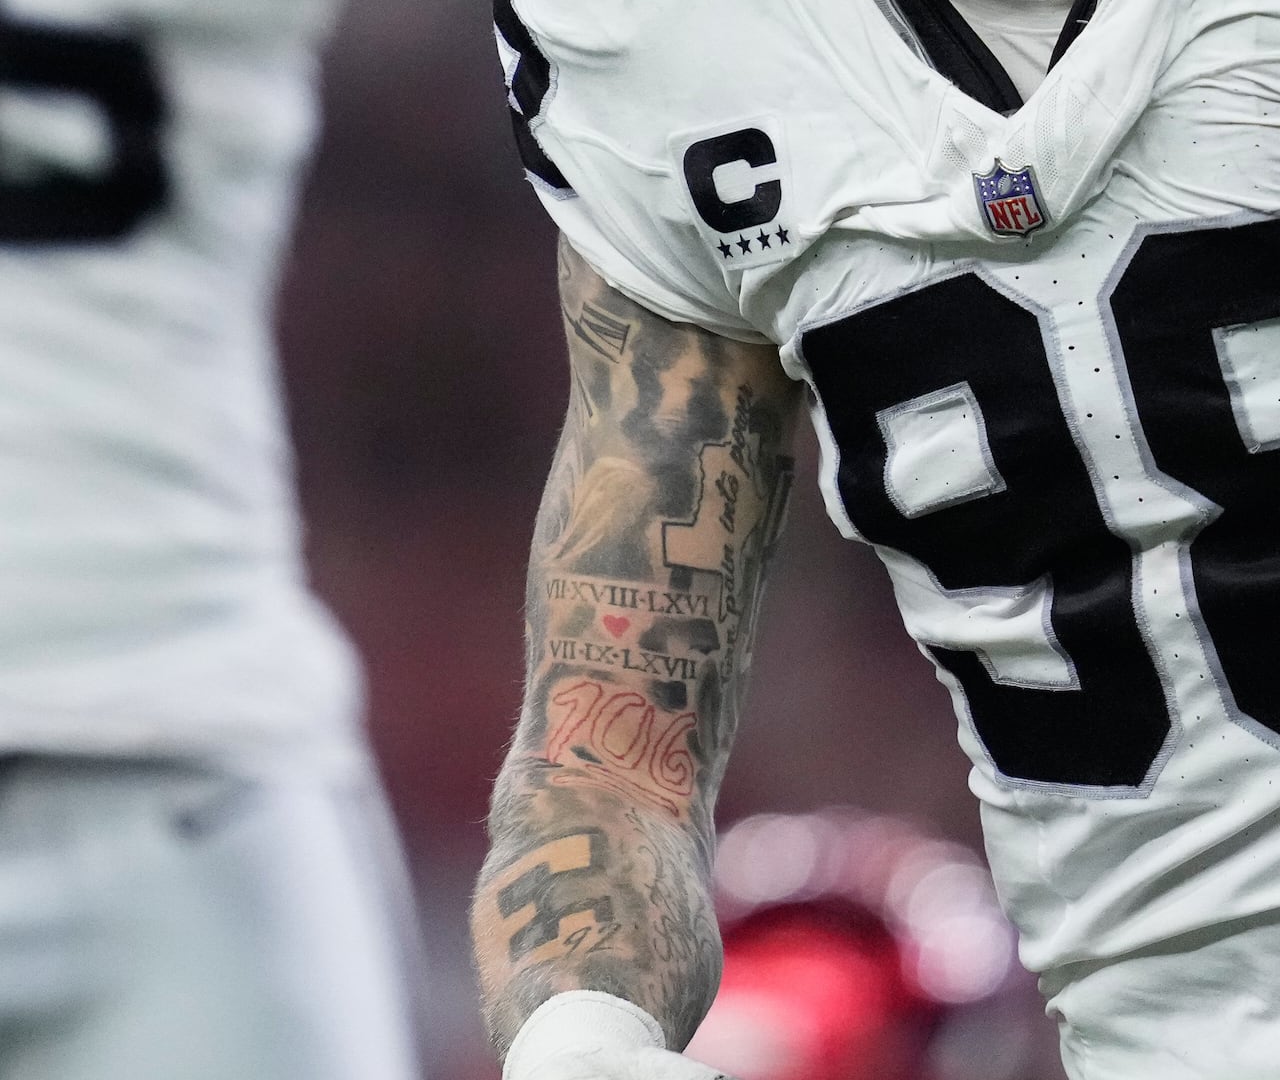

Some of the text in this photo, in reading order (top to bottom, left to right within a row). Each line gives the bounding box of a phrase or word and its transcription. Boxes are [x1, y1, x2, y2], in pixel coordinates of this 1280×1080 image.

[683, 127, 784, 233] C
[987, 196, 1041, 231] NFL
[715, 471, 739, 534] into
